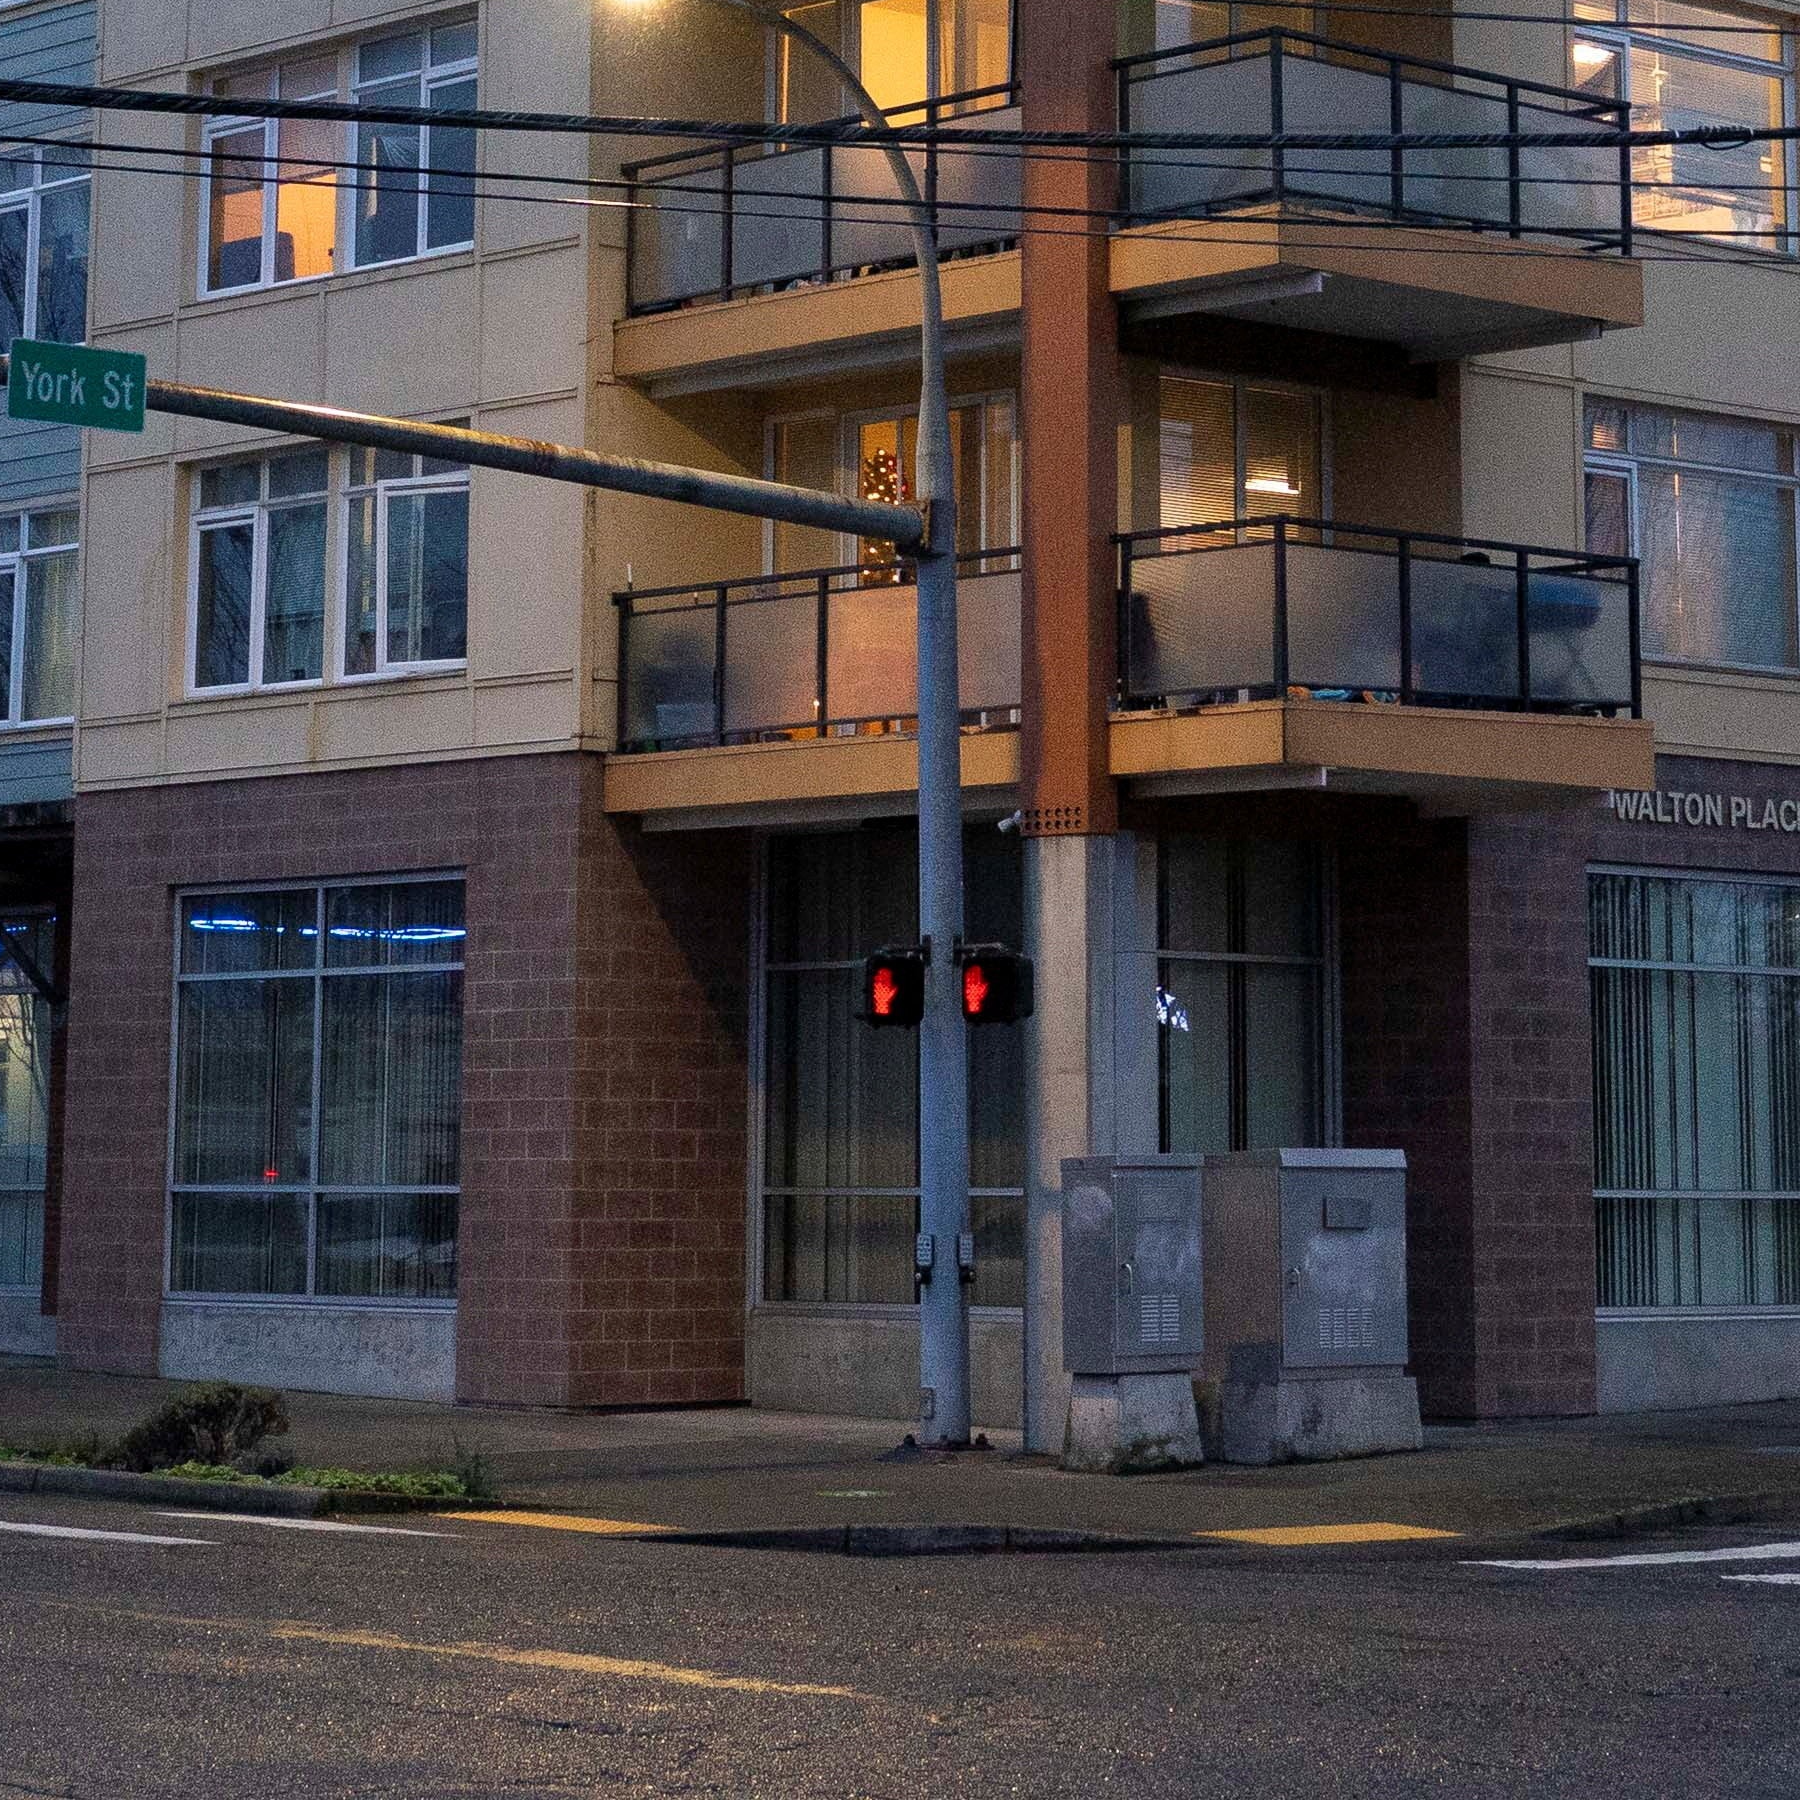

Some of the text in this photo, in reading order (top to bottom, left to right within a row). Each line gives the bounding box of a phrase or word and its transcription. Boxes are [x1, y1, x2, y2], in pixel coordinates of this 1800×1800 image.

[21, 360, 135, 411] York St
[1614, 790, 1722, 827] WALTON
